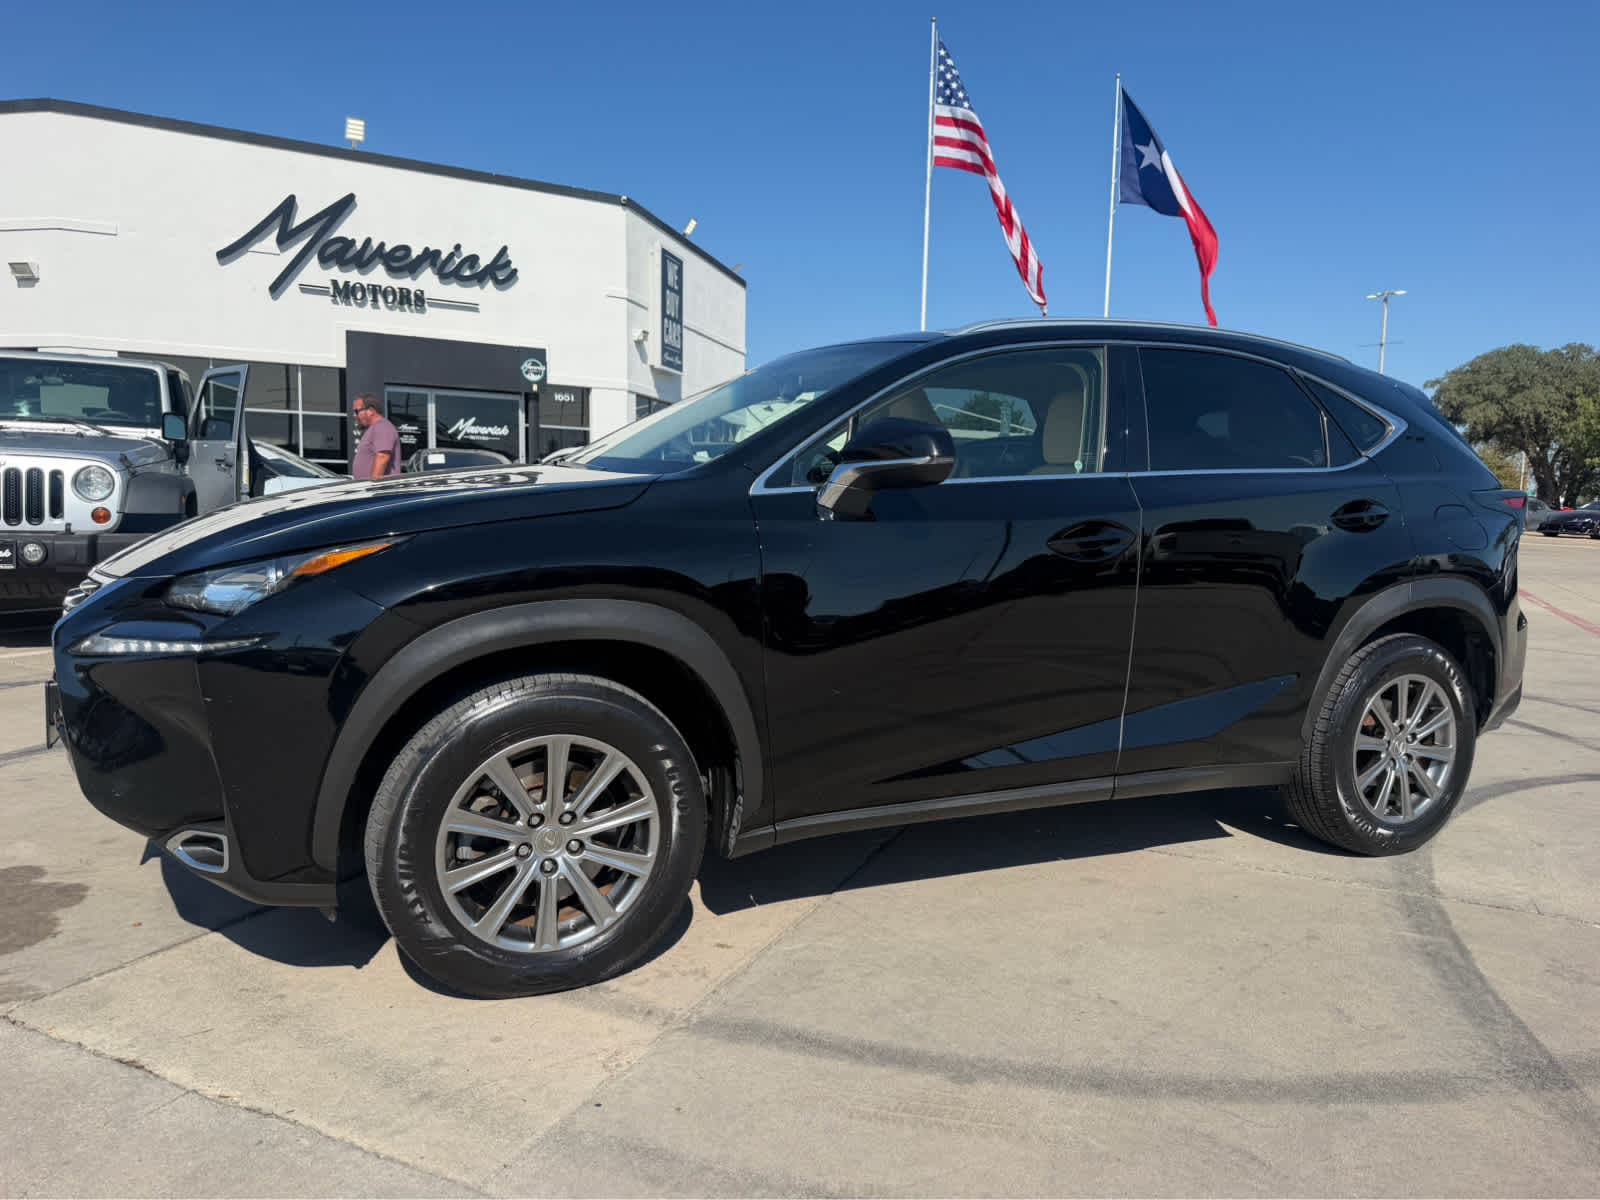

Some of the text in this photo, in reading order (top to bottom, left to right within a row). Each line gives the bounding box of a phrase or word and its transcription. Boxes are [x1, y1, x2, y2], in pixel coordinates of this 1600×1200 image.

[216, 192, 518, 300] Maverick
[329, 279, 426, 309] MOTORS
[554, 392, 575, 402] 1651
[447, 416, 510, 440] Maverick
